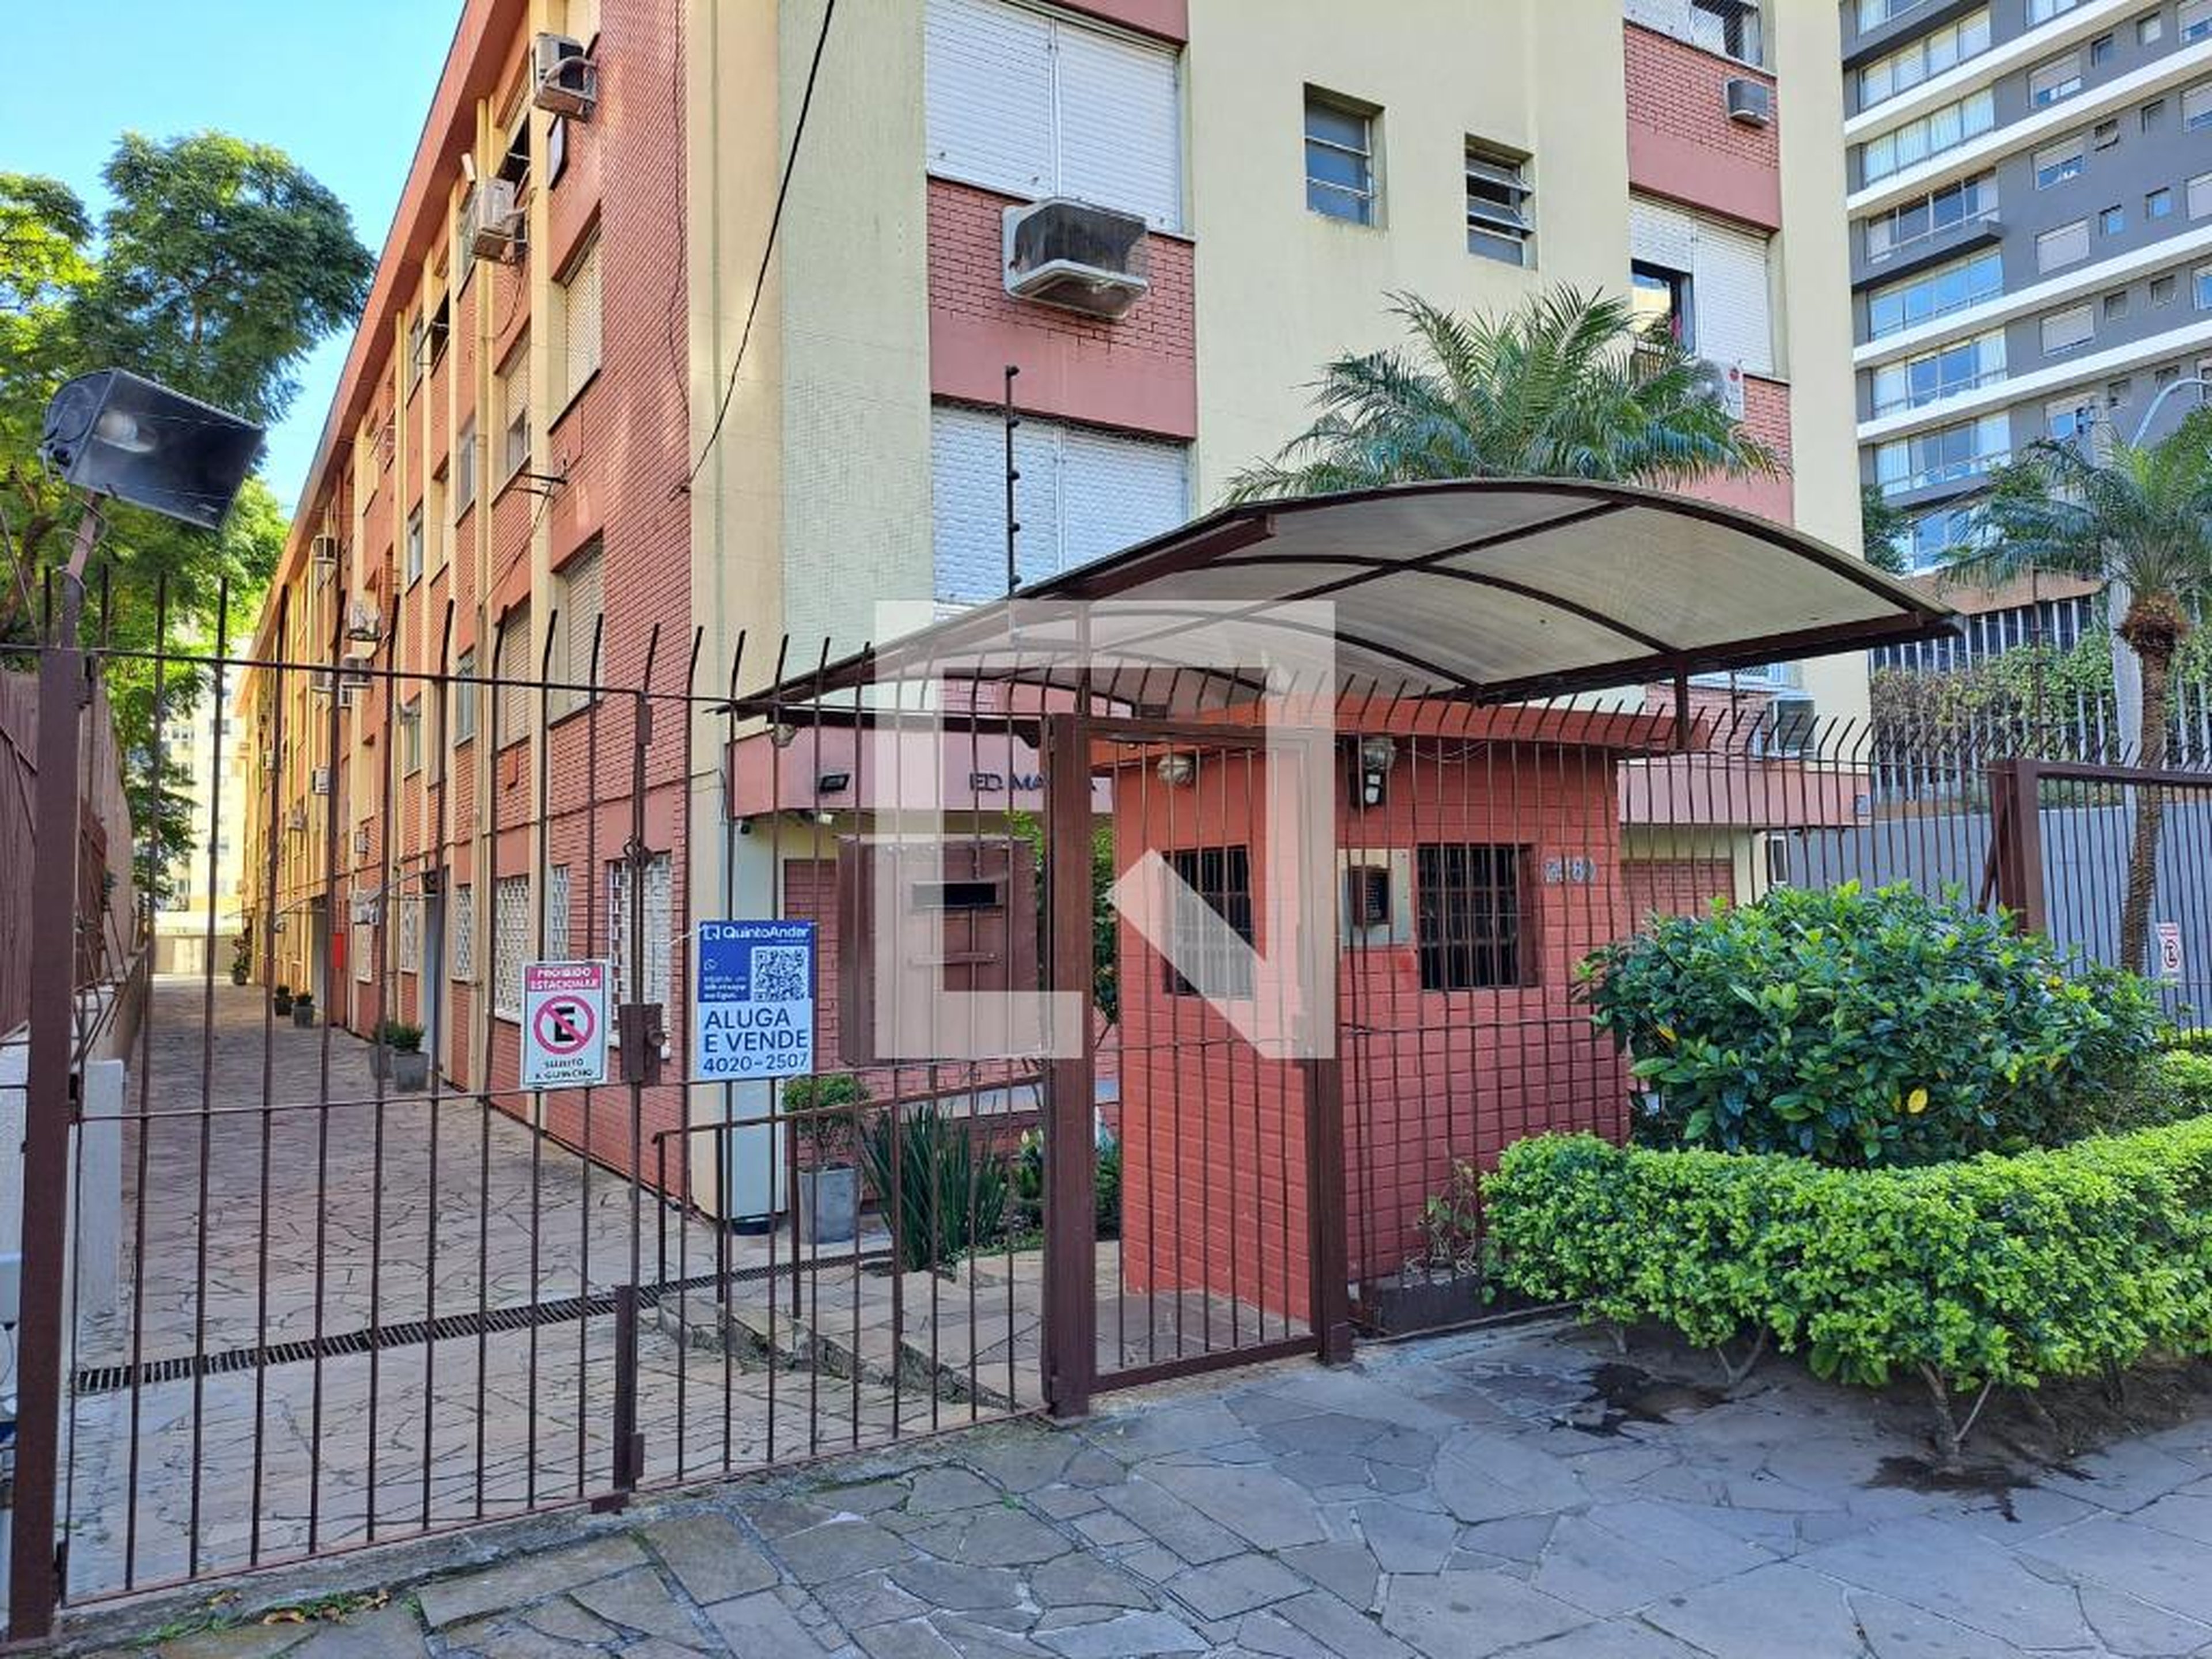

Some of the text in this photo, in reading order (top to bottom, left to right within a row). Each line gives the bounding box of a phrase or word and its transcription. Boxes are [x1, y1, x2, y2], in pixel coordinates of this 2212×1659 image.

[723, 926, 809, 939] QuintoAndar
[705, 1008, 791, 1029] ALUGA
[705, 1029, 808, 1053] E VENDE
[703, 1052, 808, 1073] 4020-2507
